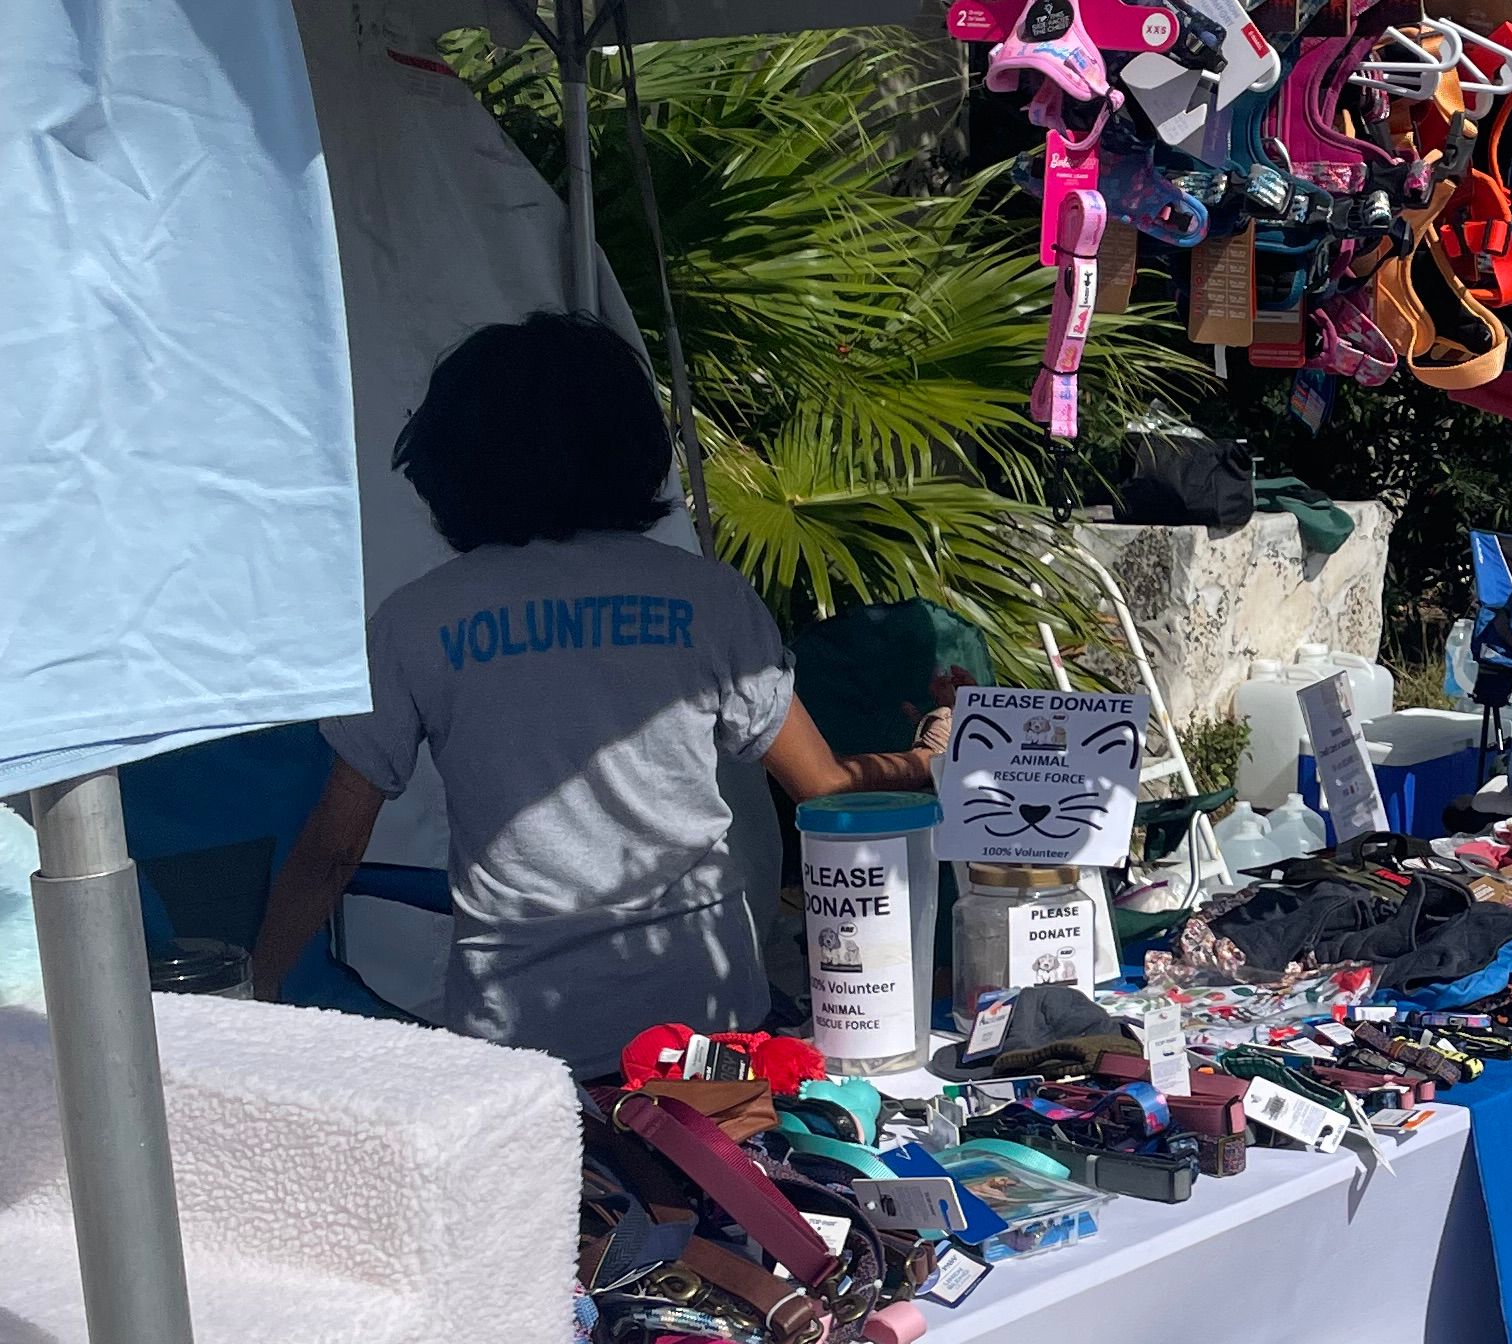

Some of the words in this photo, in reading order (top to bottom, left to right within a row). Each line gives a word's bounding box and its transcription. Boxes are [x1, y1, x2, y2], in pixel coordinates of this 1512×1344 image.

[956, 10, 967, 26] 2
[1146, 25, 1167, 34] XXS
[438, 595, 695, 672] VOLUNTEER
[968, 693, 1045, 710] PLEASE
[1050, 697, 1133, 714] DONATE
[1010, 755, 1069, 768] ANIMAL
[994, 771, 1041, 783] RESCUE
[1044, 773, 1085, 784] FORCE
[982, 846, 1012, 857] 100%
[1014, 847, 1070, 858] Volunteer
[1031, 906, 1079, 921] PLEASE
[1029, 927, 1081, 942] DONATE
[829, 981, 895, 995] Volunteer
[821, 1002, 865, 1016] ANIMAL
[846, 1019, 880, 1031] FORCE
